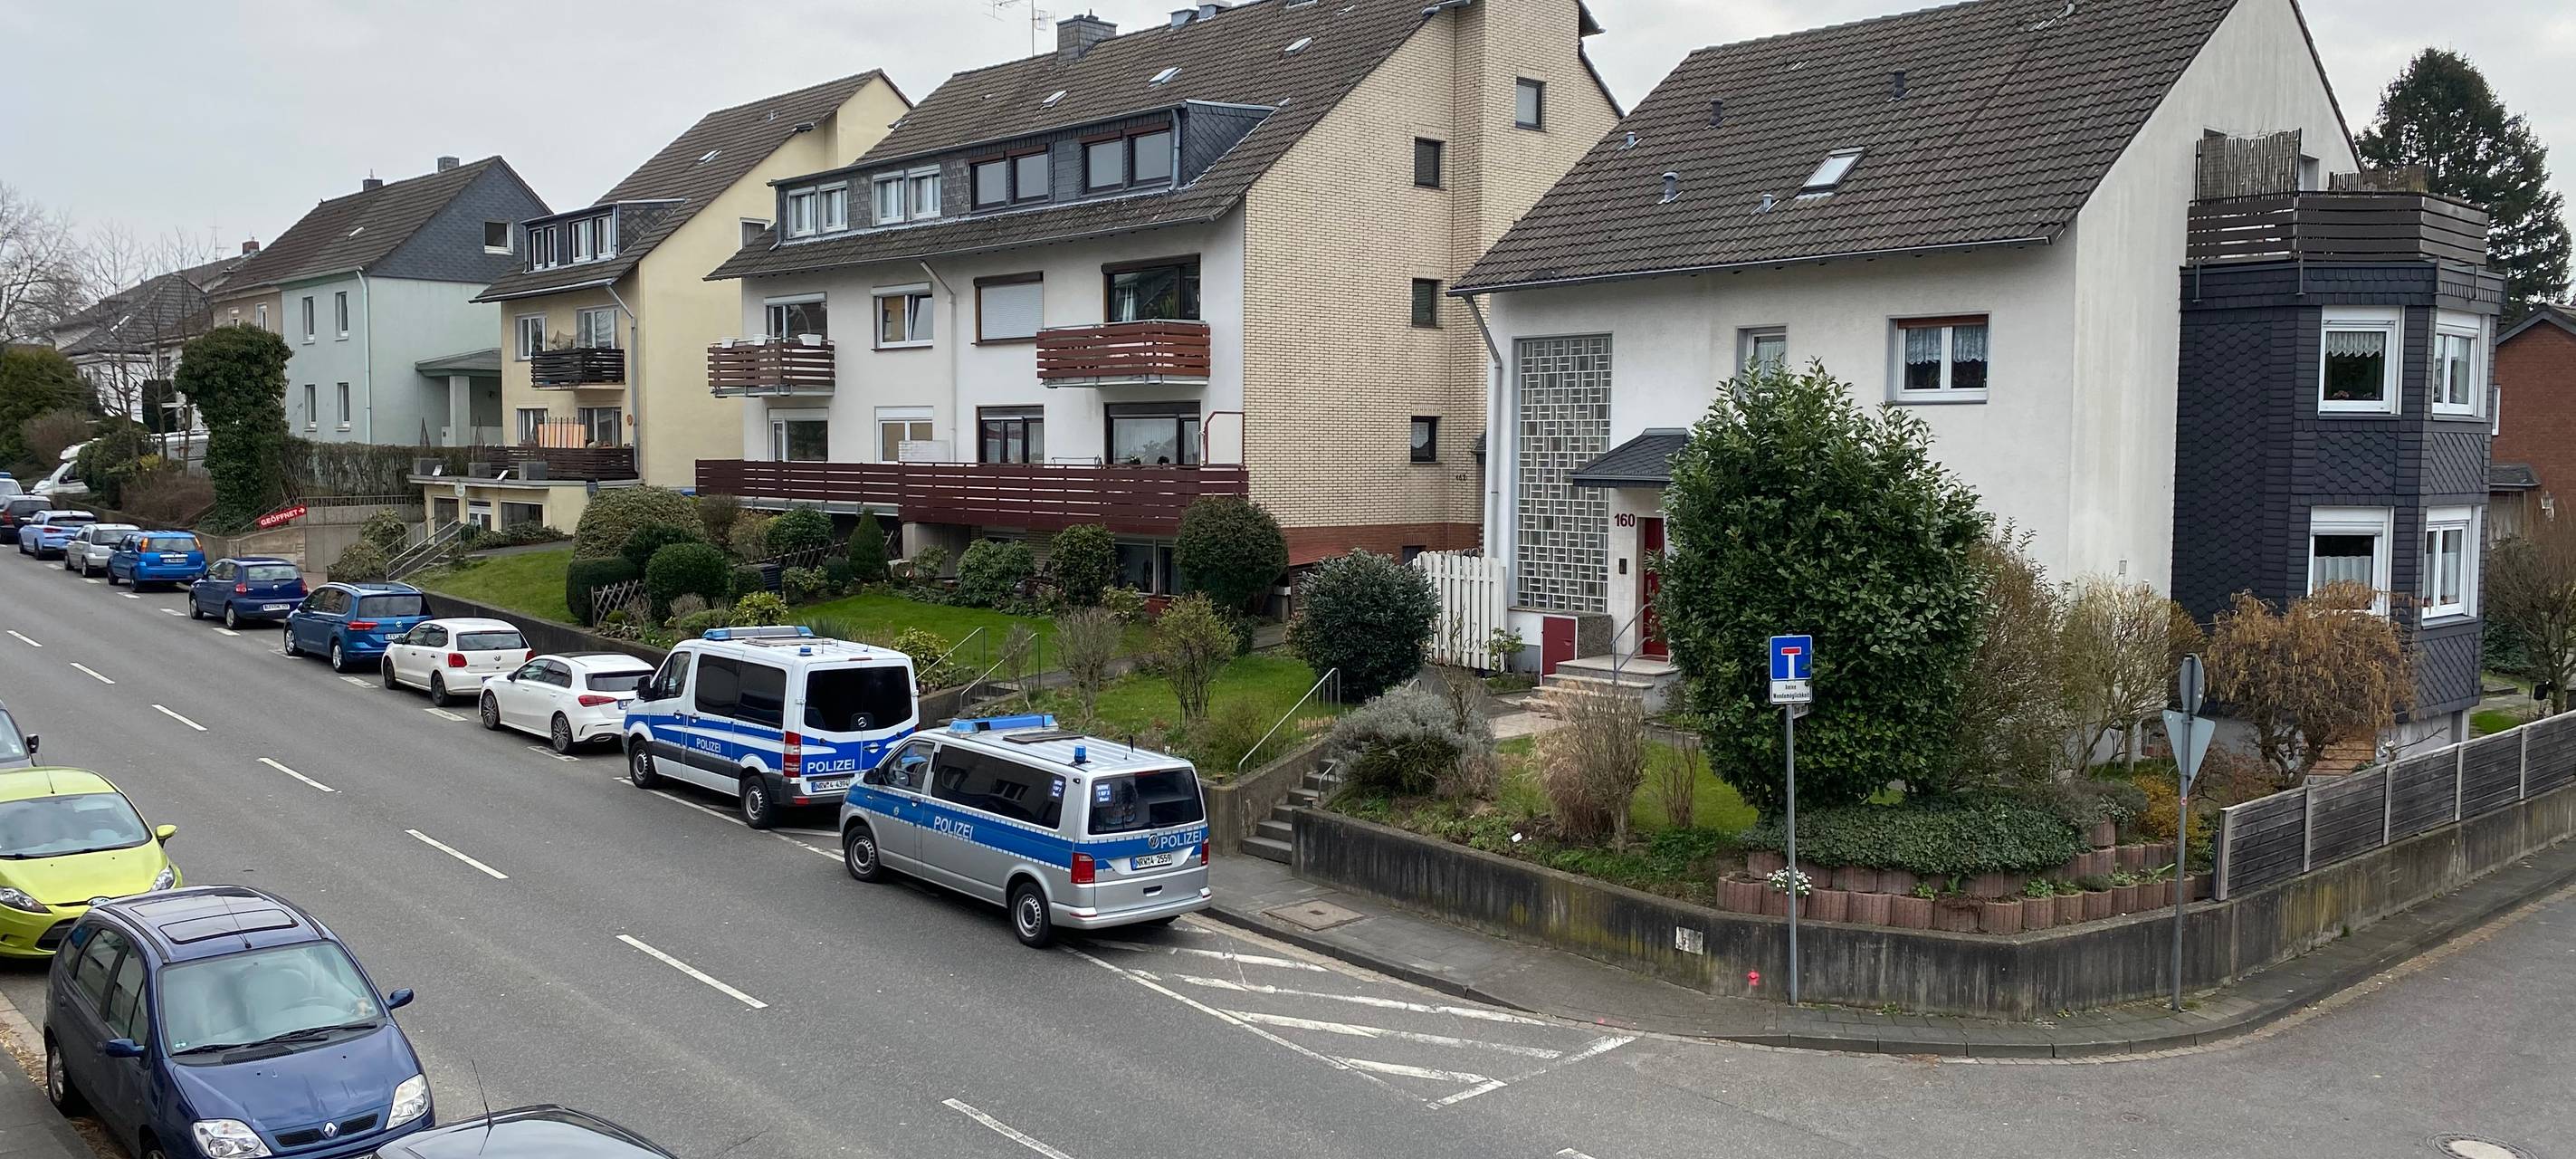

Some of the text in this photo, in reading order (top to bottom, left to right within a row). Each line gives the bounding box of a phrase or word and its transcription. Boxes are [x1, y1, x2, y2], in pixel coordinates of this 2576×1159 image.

[261, 509, 298, 525] GEÖFFNET
[1614, 512, 1636, 527] 160
[696, 737, 721, 753] POLIZEI
[807, 759, 855, 773] POLIZEI
[933, 816, 974, 840] POLIZEI
[1160, 830, 1202, 848] POLIZEI
